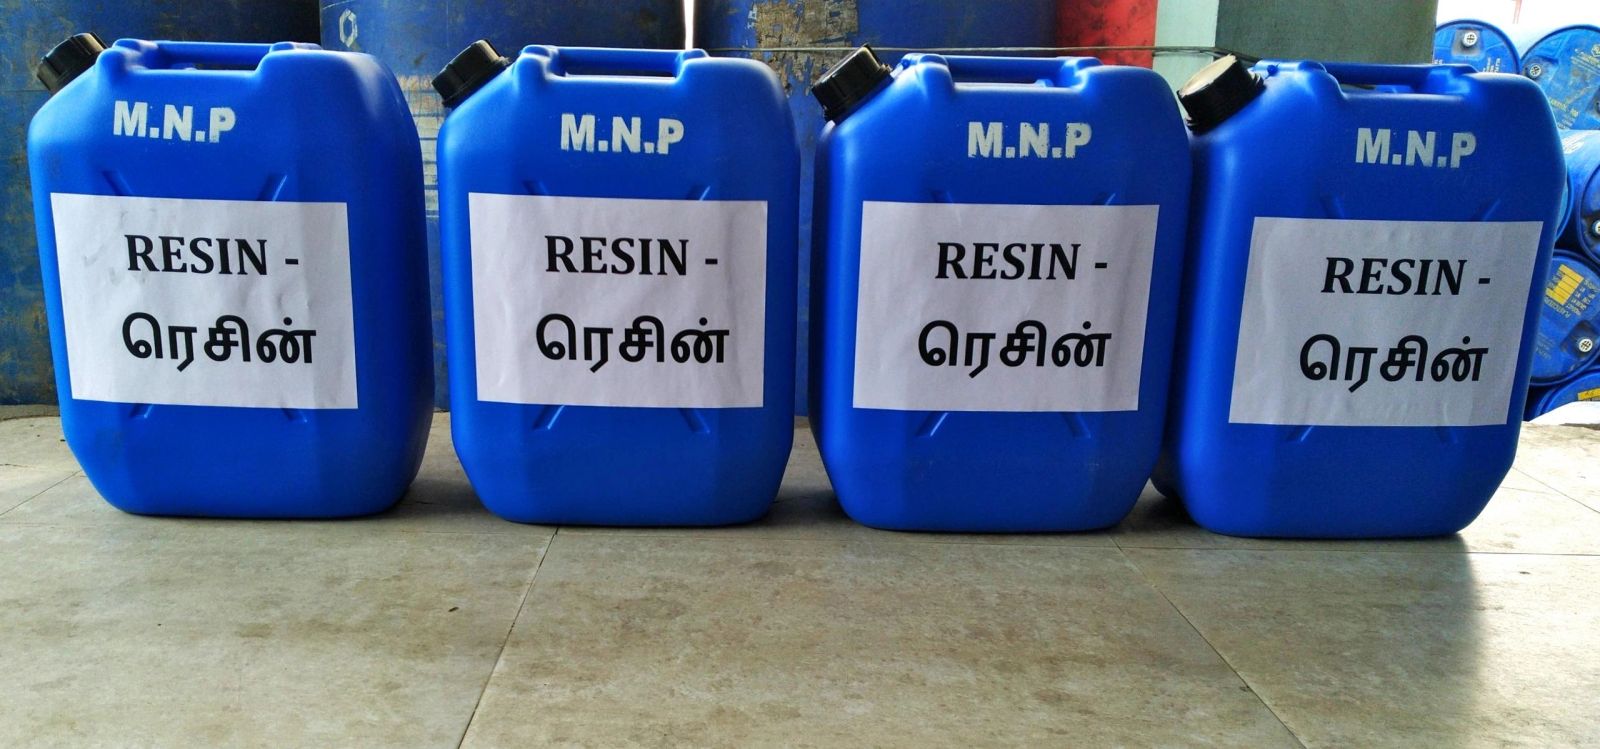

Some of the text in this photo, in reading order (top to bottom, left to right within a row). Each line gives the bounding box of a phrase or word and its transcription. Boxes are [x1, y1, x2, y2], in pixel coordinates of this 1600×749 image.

[113, 100, 236, 142] M.N.P
[560, 113, 684, 155] M.N.P
[967, 120, 1092, 159] M.N.P
[1355, 127, 1477, 170] M.N.P
[125, 234, 299, 276] RESIN -
[544, 235, 718, 277] RESIN -
[935, 242, 1108, 281] RESIN -
[1320, 256, 1492, 297] RESIN -
[122, 312, 317, 372] ரெசின்
[535, 313, 730, 373] ரெசின்
[917, 319, 1113, 379] ரெசின்
[1299, 333, 1489, 393] ரெசின்
